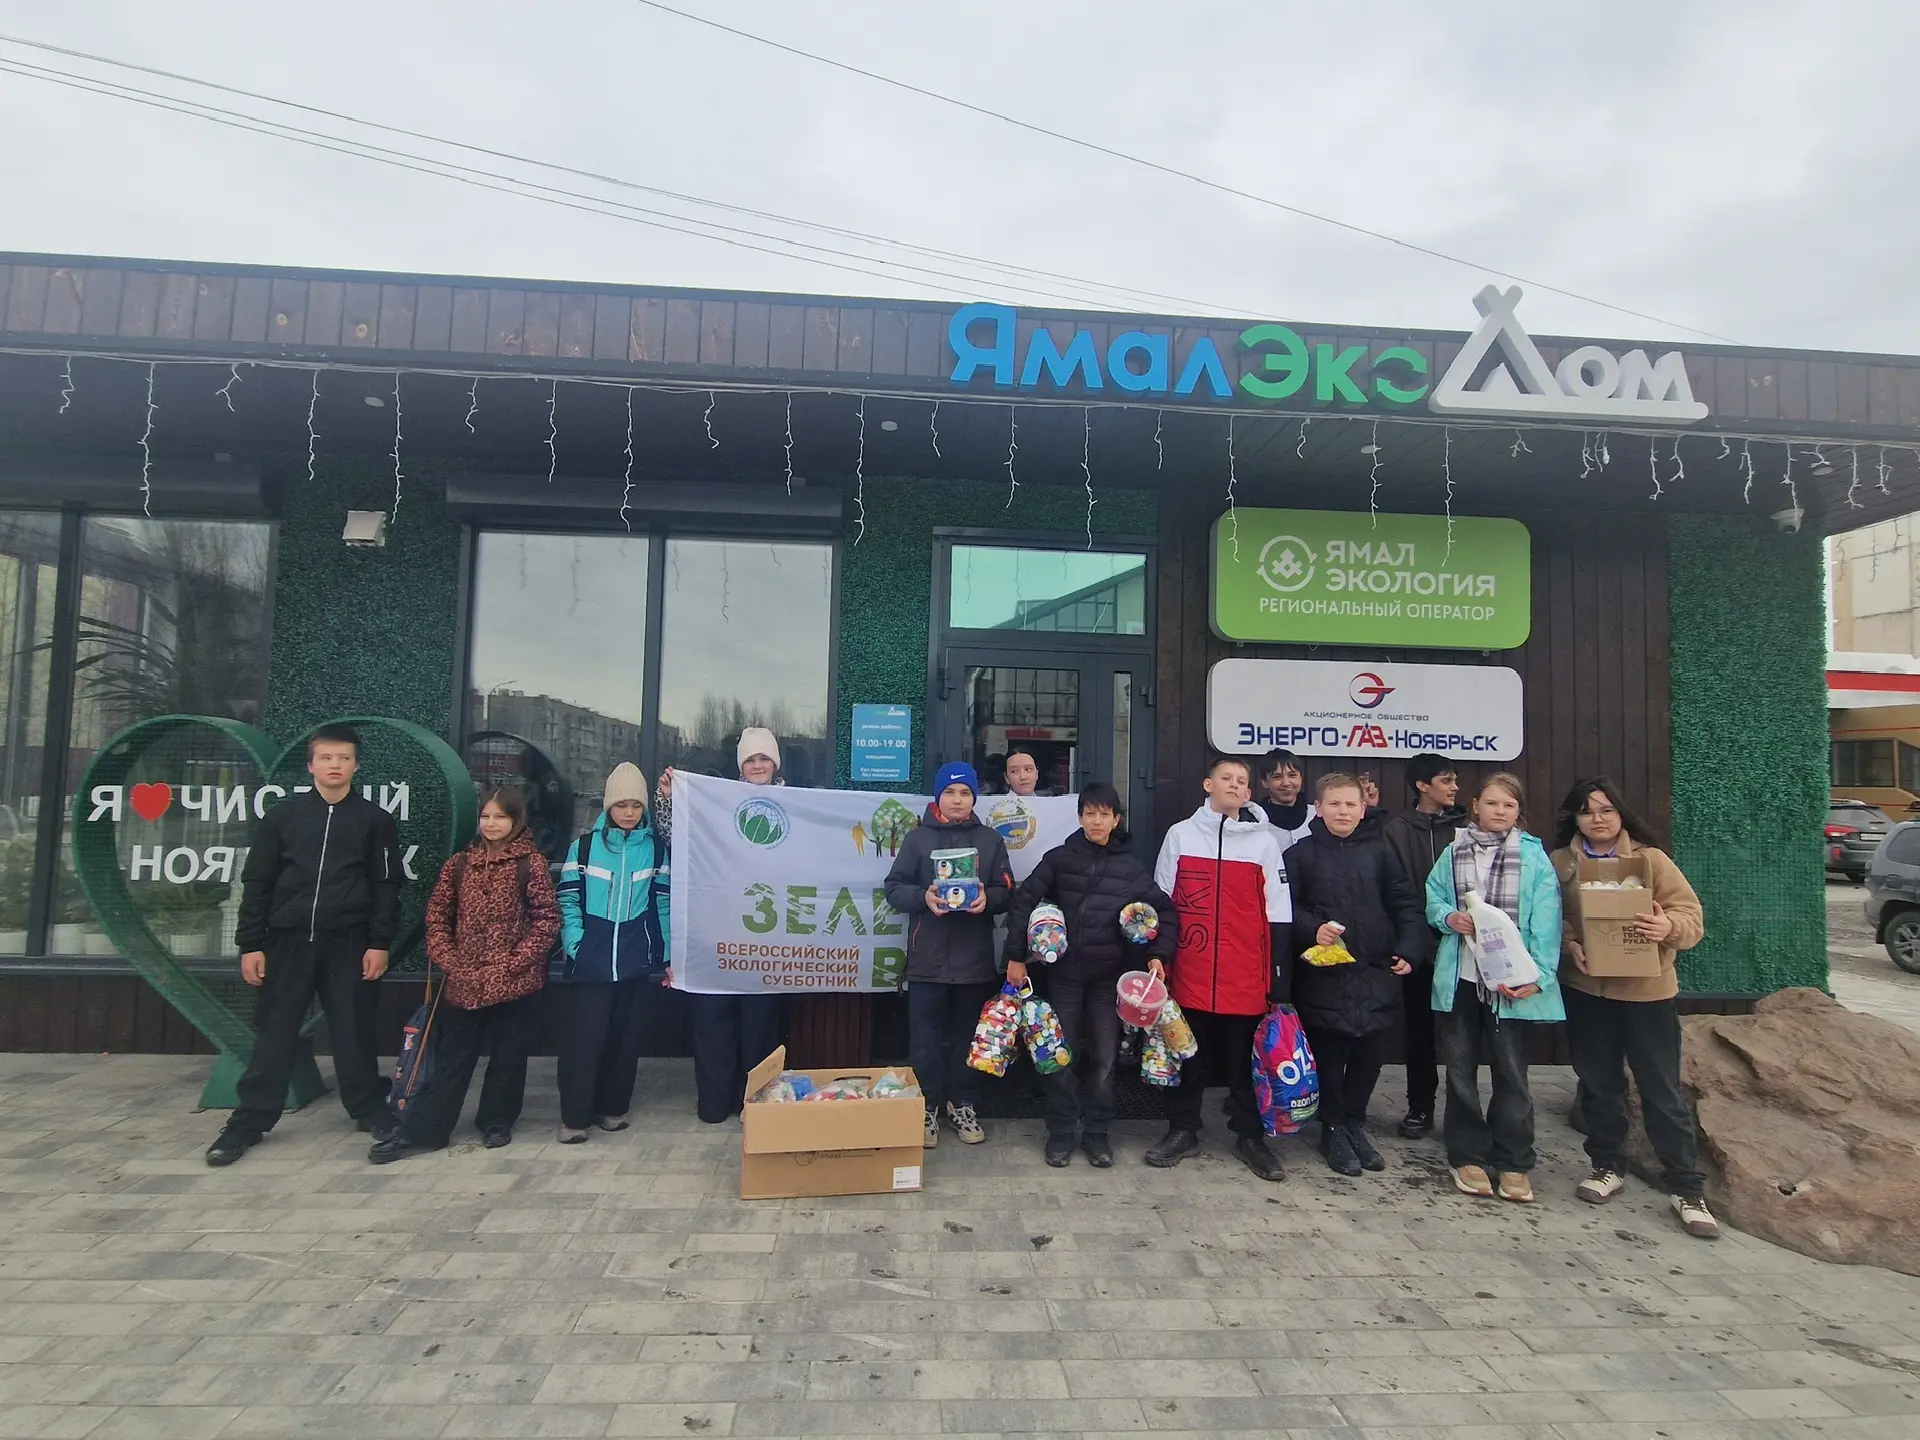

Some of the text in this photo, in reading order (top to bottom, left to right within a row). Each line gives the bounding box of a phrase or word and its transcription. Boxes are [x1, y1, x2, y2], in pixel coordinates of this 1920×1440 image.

[1325, 540, 1416, 567] ЯМАЛ
[1325, 568, 1496, 598] ЭКОЛОГИЯ
[1259, 597, 1495, 621] РЕГИОНАЛЬНЫЙ ОПЕРАТОР
[1303, 711, 1430, 722] АКЦИОНЕРНОЕ ОБЩЕСТВО
[88, 781, 409, 824] Я ЧИСЙ
[716, 942, 860, 961] ВСЕРОССИЙСКИЙ
[717, 958, 859, 975] ЭКОЛОГИЧЕСКИЙ
[762, 975, 858, 987] СУББОТНИК
